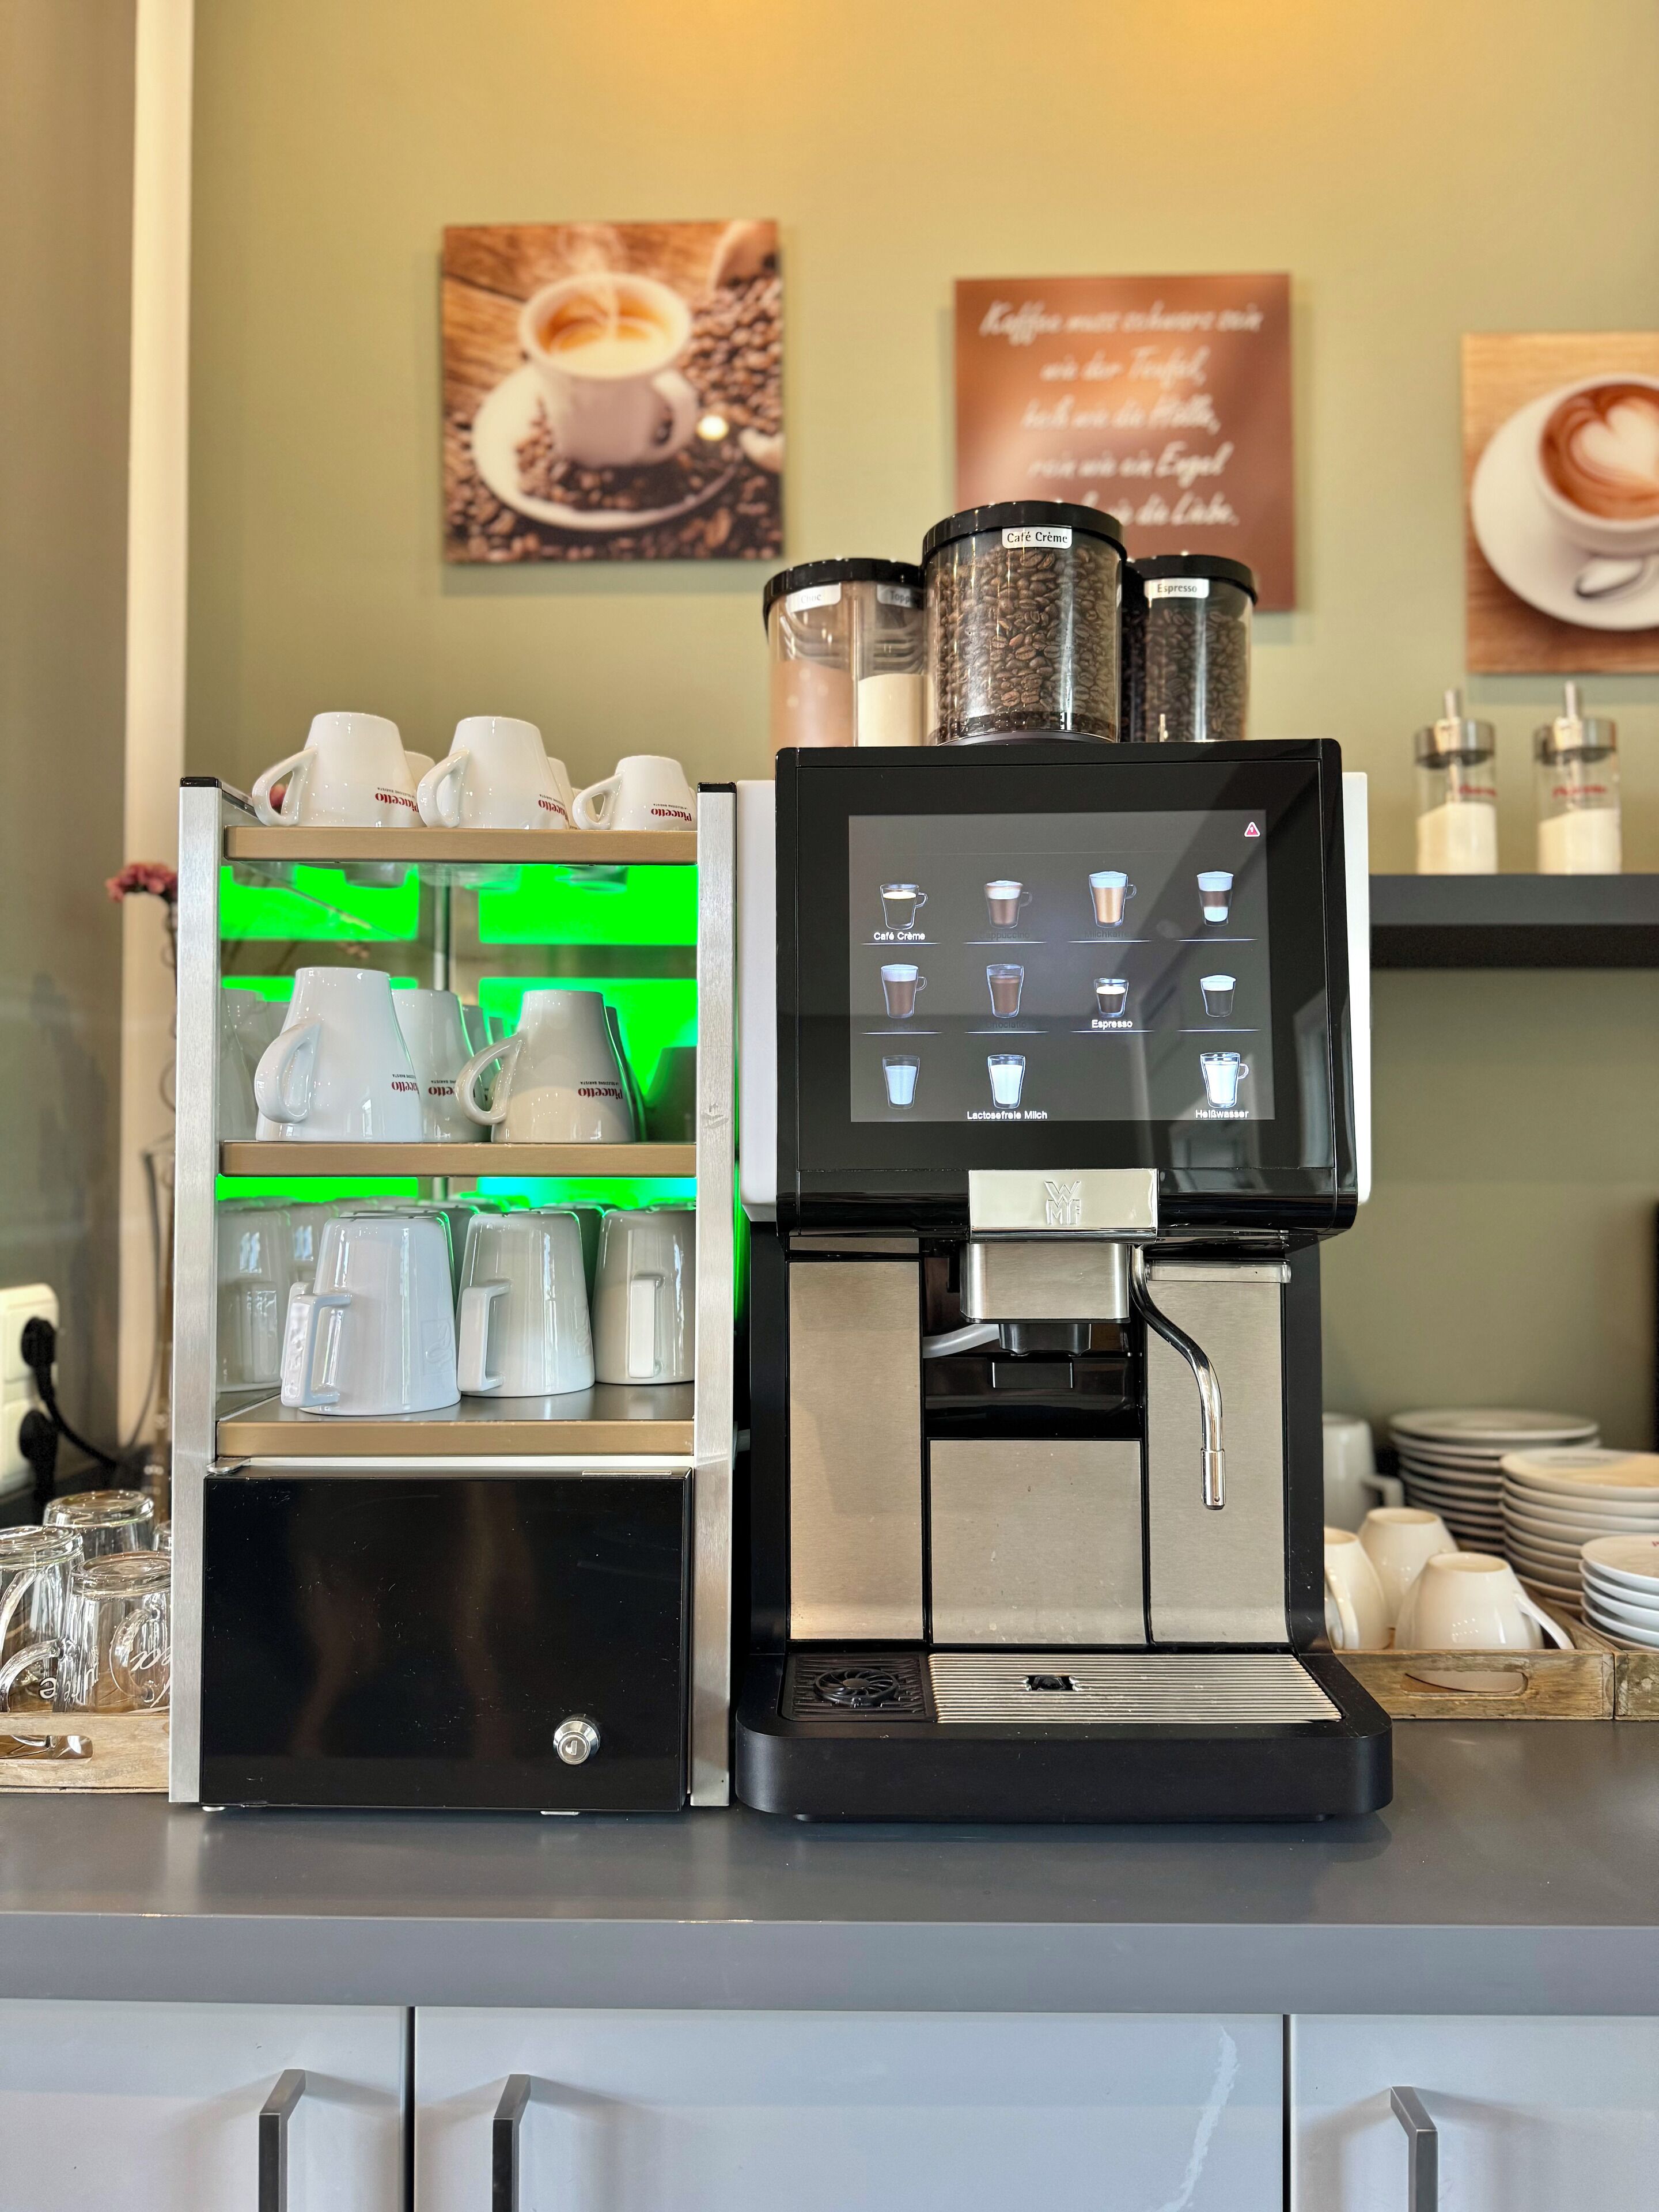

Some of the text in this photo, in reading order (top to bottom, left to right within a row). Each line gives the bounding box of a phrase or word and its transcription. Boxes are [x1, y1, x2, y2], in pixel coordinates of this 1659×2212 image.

[1007, 531, 1068, 543] Café Crème
[1157, 584, 1197, 594] Espresso
[650, 808, 692, 821] Piacetto
[873, 931, 925, 941] Café Crème
[1092, 1019, 1133, 1030] Espresso
[578, 1088, 623, 1100] Piacetto
[967, 1110, 1048, 1120] Lactosefreie Milch
[1195, 1109, 1249, 1119] Heißwasser
[1044, 1181, 1081, 1225] WMF
